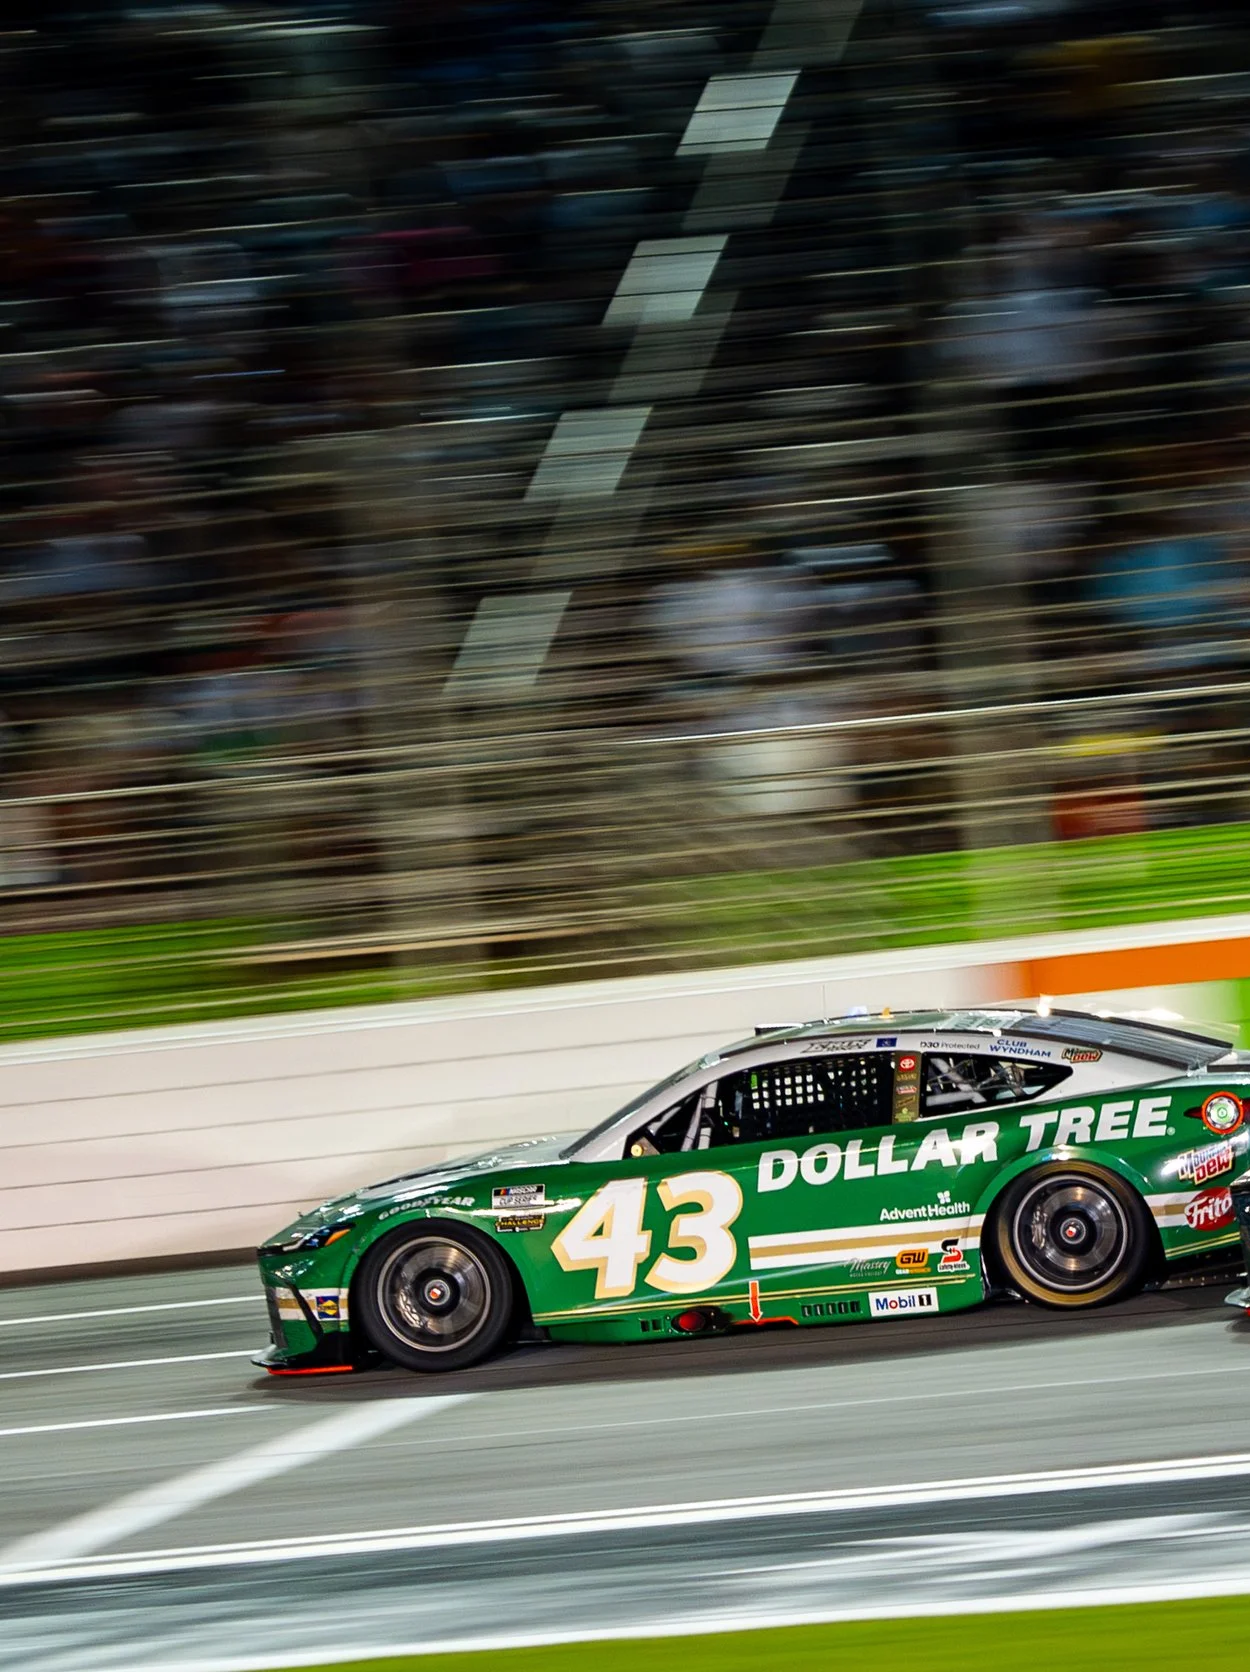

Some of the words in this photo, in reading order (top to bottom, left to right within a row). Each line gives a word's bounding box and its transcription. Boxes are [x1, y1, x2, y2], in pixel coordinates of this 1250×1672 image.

[989, 1044, 1052, 1058] WYNDHAM
[996, 1038, 1027, 1048] CLUB
[756, 1121, 1000, 1193] DOLLAR
[1020, 1096, 1172, 1152] TREE
[378, 1195, 476, 1221] GOODYEAR
[880, 1201, 971, 1221] AdventHealth
[551, 1170, 744, 1299] 43
[900, 1251, 926, 1265] GW
[875, 1294, 917, 1311] Mobil
[918, 1293, 932, 1306] 1
